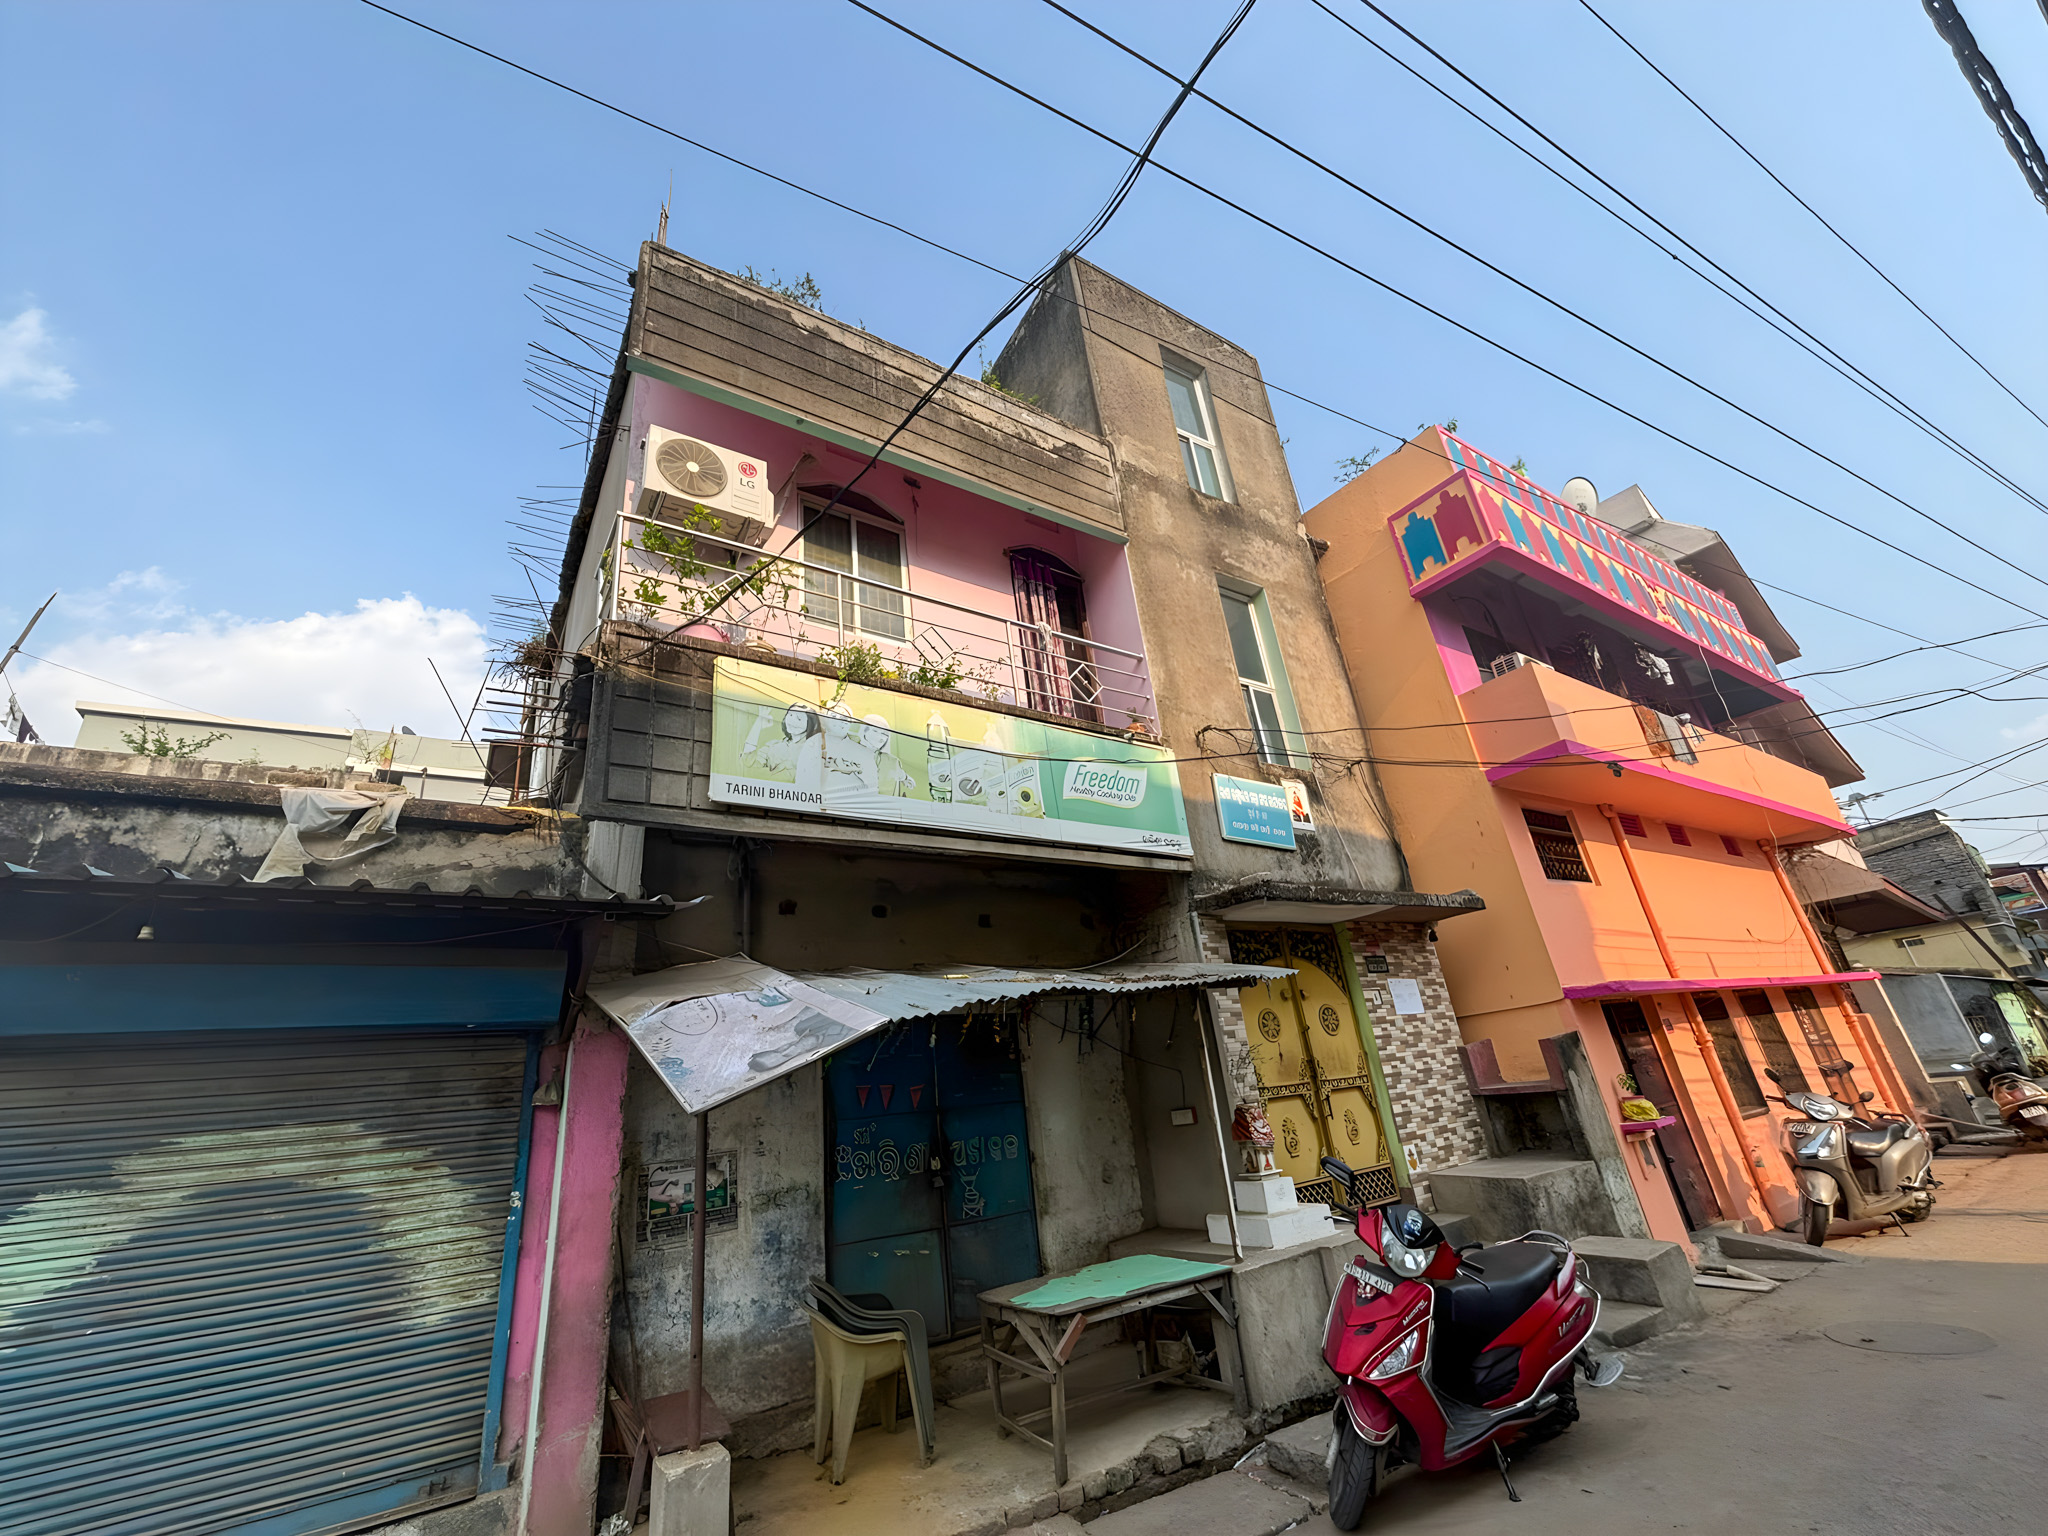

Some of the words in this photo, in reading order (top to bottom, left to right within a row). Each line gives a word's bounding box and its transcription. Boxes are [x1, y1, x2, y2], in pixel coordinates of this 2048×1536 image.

[740, 477, 755, 489] LG
[1073, 764, 1140, 795] Freedom
[725, 782, 765, 798] TARINI
